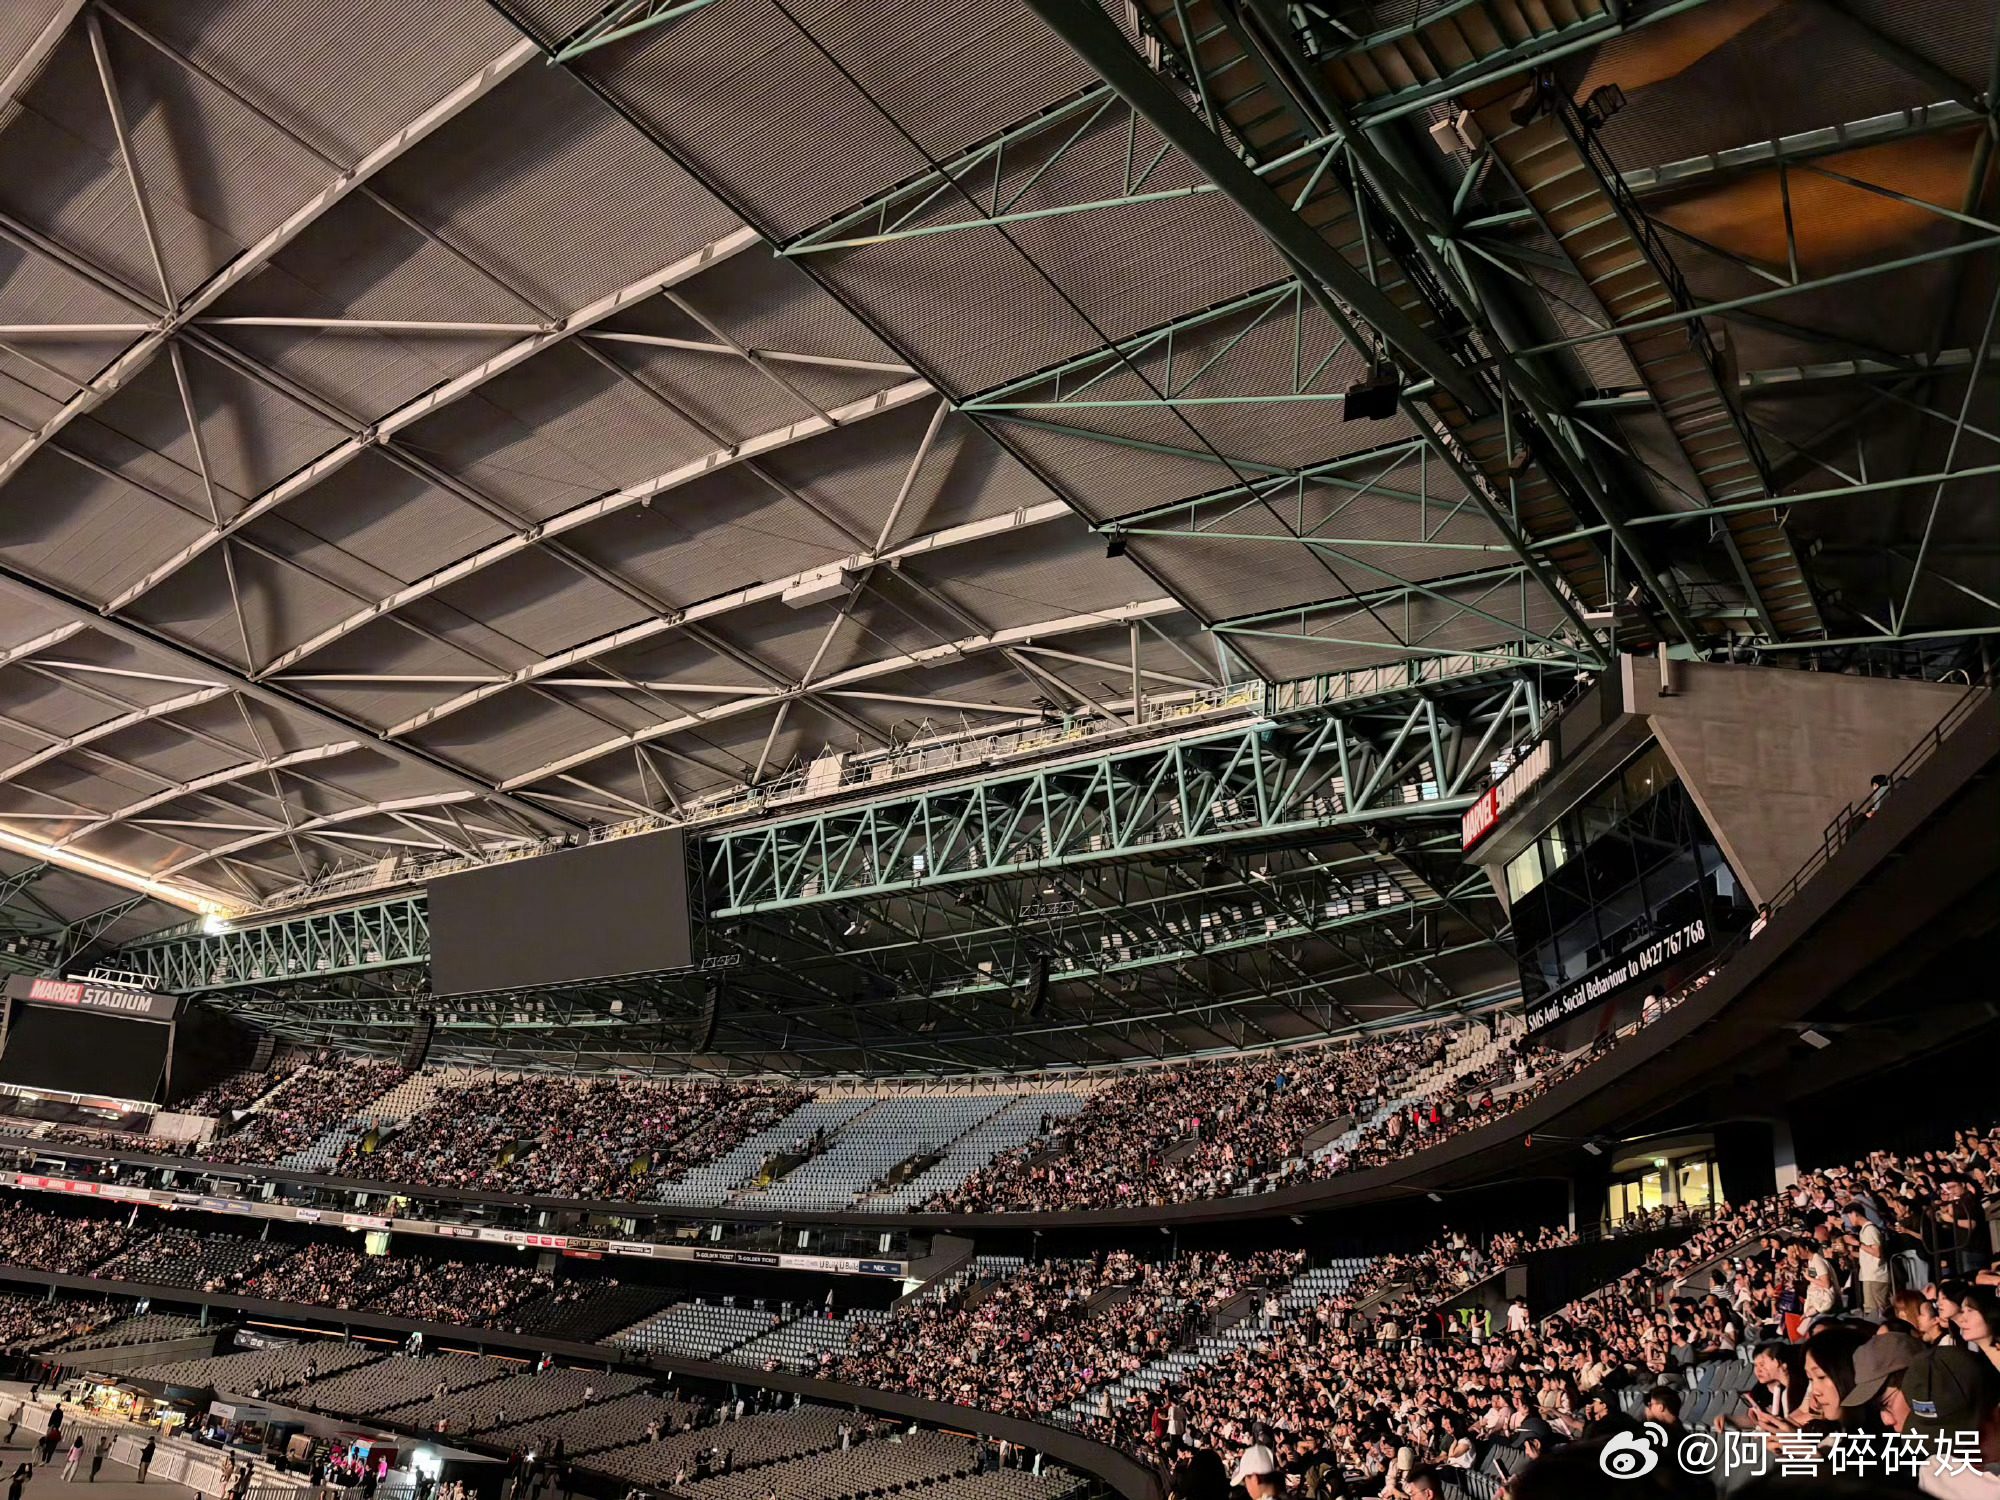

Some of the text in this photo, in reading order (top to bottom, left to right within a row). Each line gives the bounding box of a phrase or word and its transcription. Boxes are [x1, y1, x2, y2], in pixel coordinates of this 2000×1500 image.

[1462, 739, 1551, 849] MARVEL STADIUM
[1528, 1006, 1544, 1033] SMS
[1586, 966, 1627, 1005] Behaviour
[1627, 959, 1639, 978] to
[1639, 944, 1663, 971] 0427
[1663, 930, 1682, 958] 767
[1683, 919, 1705, 948] 768
[31, 980, 153, 1012] MARVEL STADIUM
[73, 1182, 93, 1193] MARVEL
[873, 1264, 886, 1272] NEC
